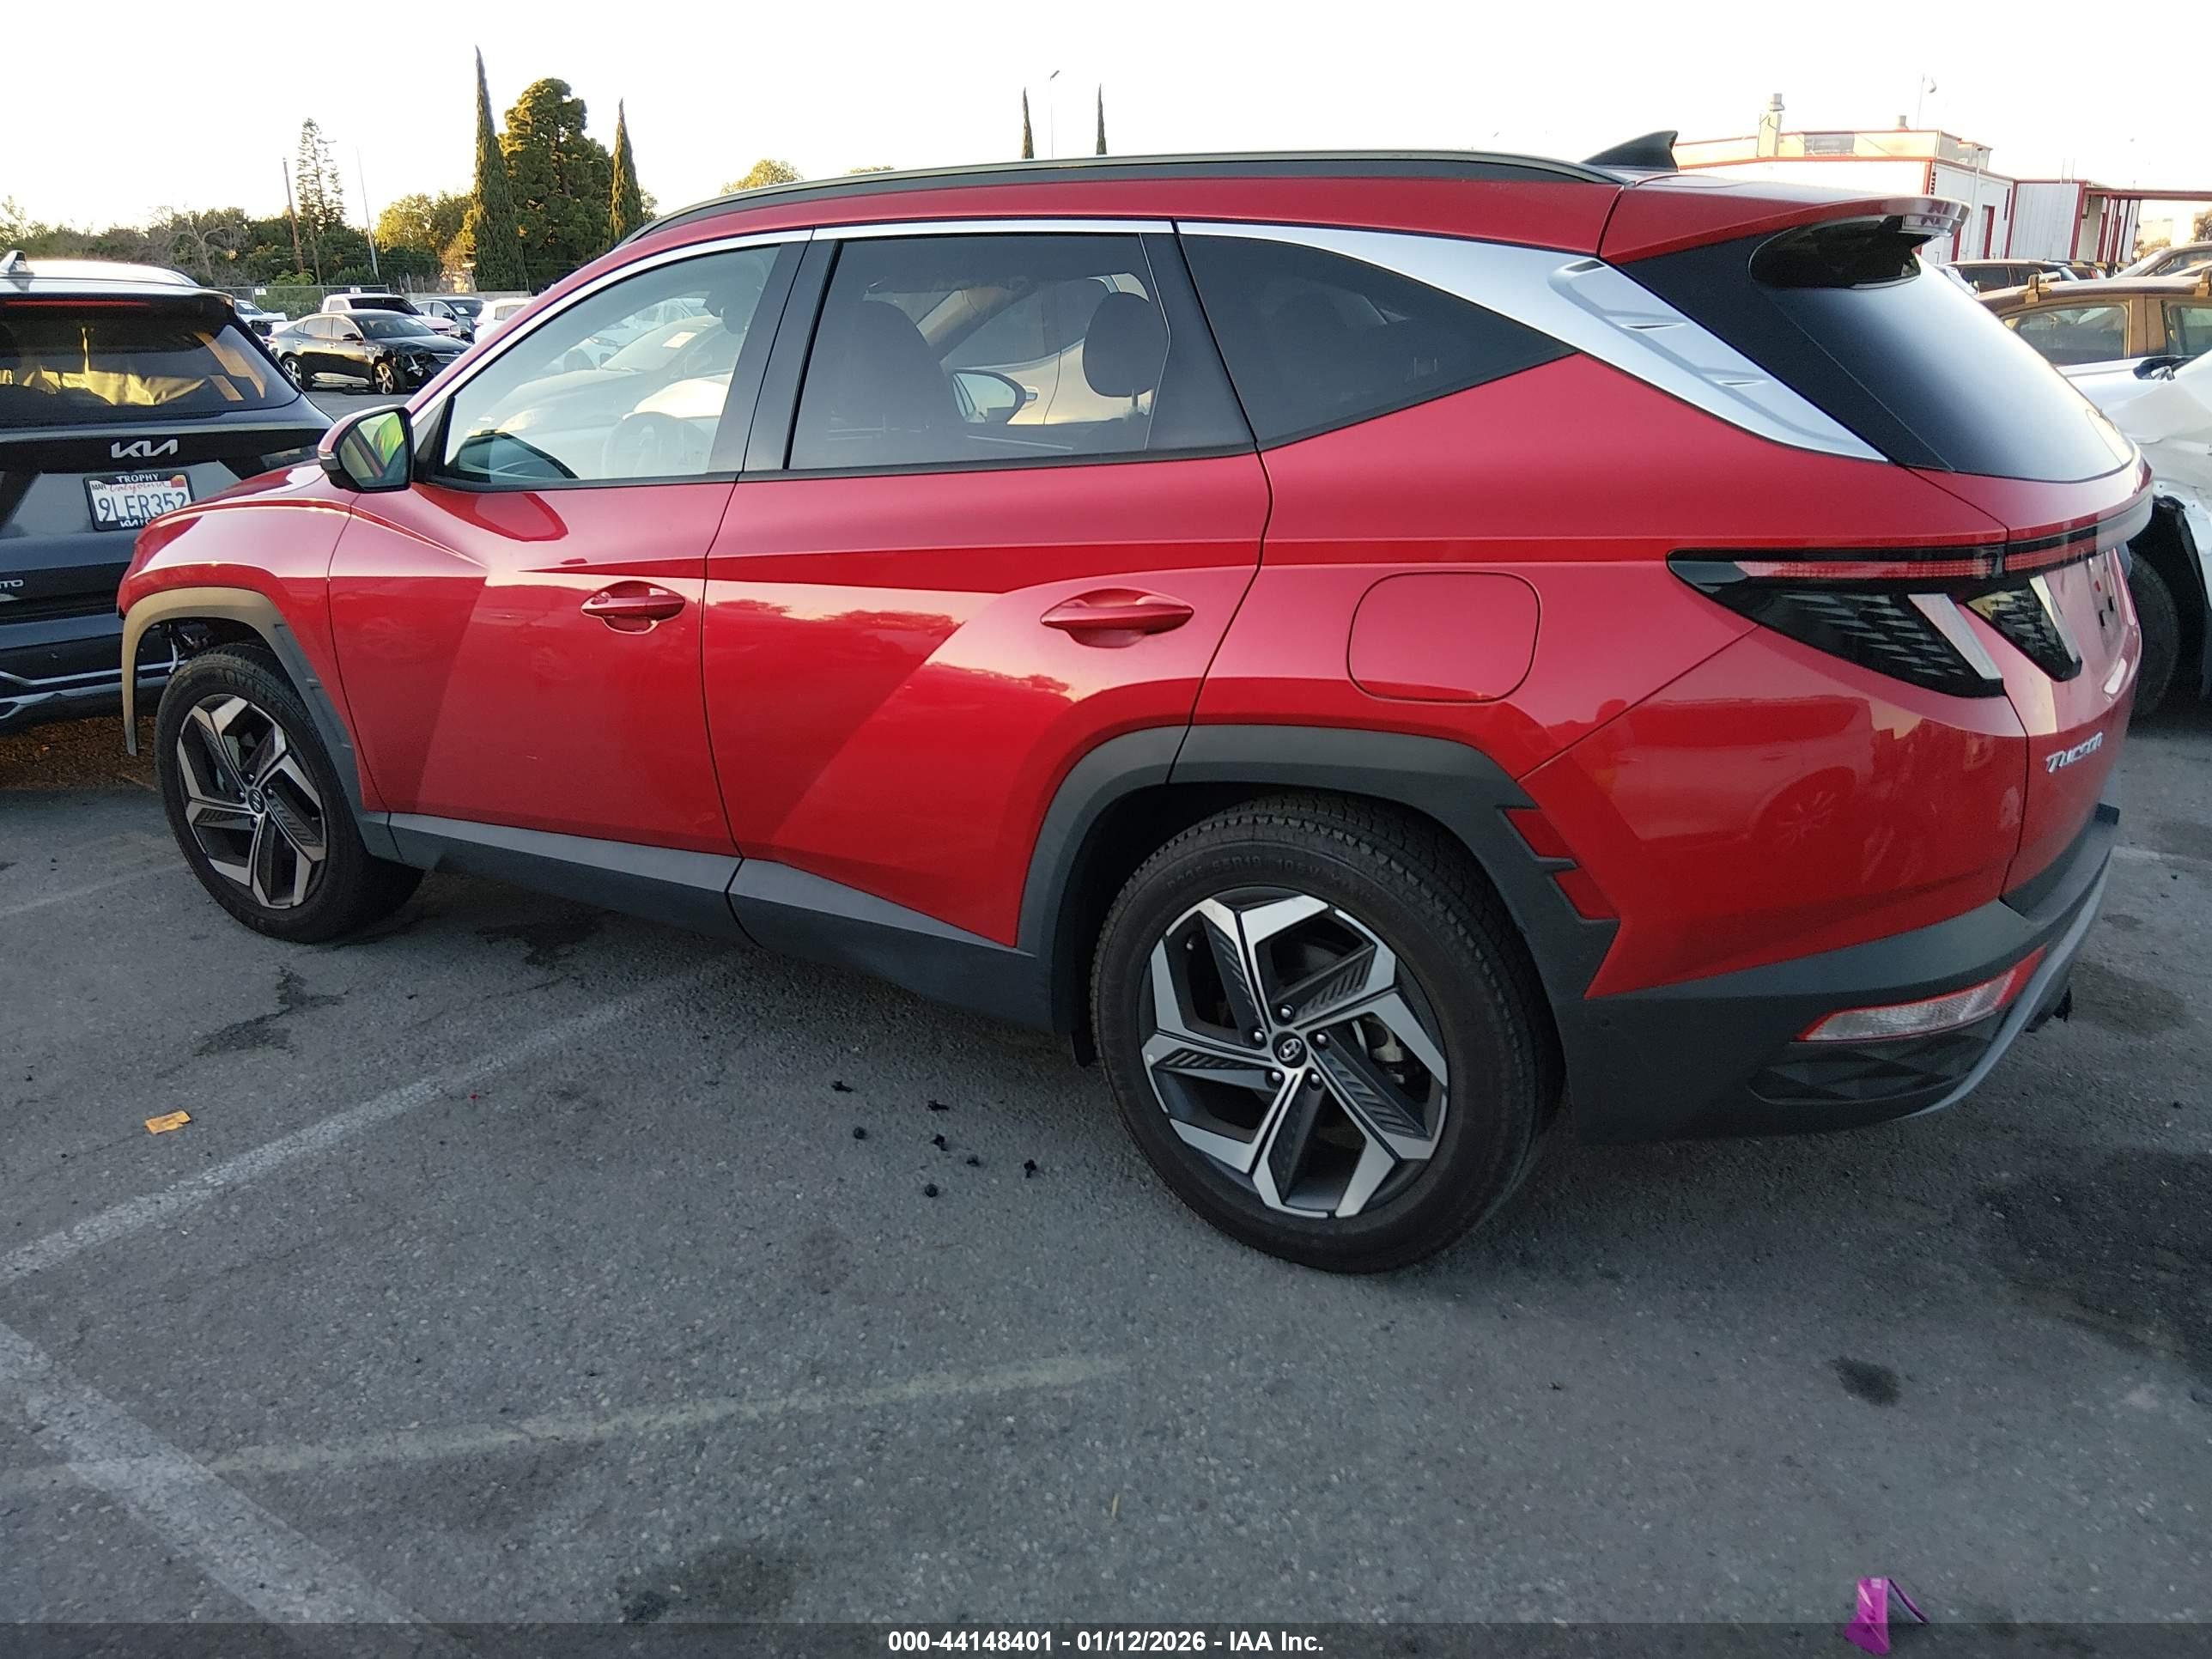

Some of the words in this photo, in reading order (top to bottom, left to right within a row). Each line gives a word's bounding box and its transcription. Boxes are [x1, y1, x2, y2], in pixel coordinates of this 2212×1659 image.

[111, 439, 179, 459] KIA
[116, 473, 159, 483] TROPHY
[98, 491, 187, 522] 9LER352
